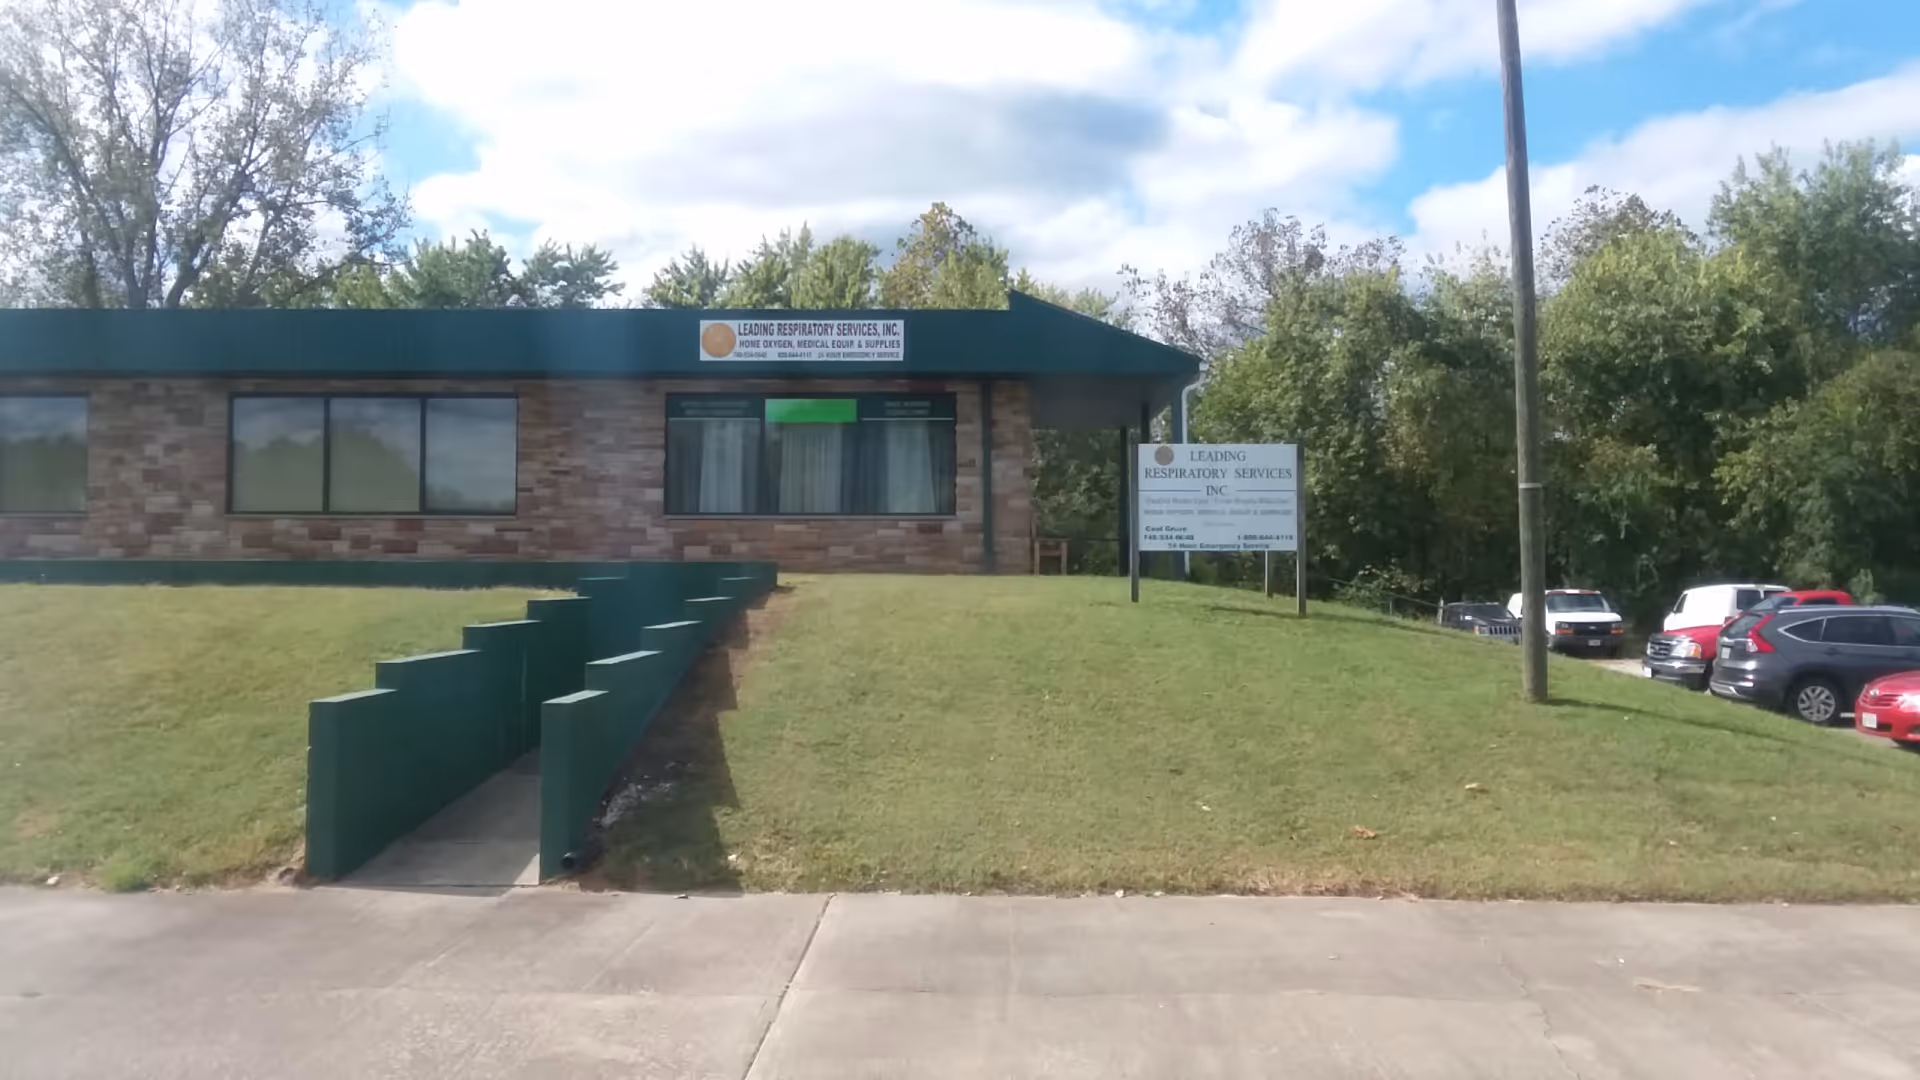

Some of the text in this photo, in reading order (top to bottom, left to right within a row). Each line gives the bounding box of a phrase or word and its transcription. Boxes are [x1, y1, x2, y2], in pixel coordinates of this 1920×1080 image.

[738, 323, 900, 338] LEADING RESPIRATORY SERVICES, INC.
[739, 340, 760, 348] HOME
[763, 340, 795, 349] OXYGEN,
[797, 340, 829, 348] MEDICAL
[857, 340, 863, 348] &
[865, 340, 900, 348] SUPPLIES
[1190, 450, 1246, 462] LEADING
[1144, 468, 1292, 479] RESPIRATORY SERVICES
[1206, 485, 1228, 496] INC
